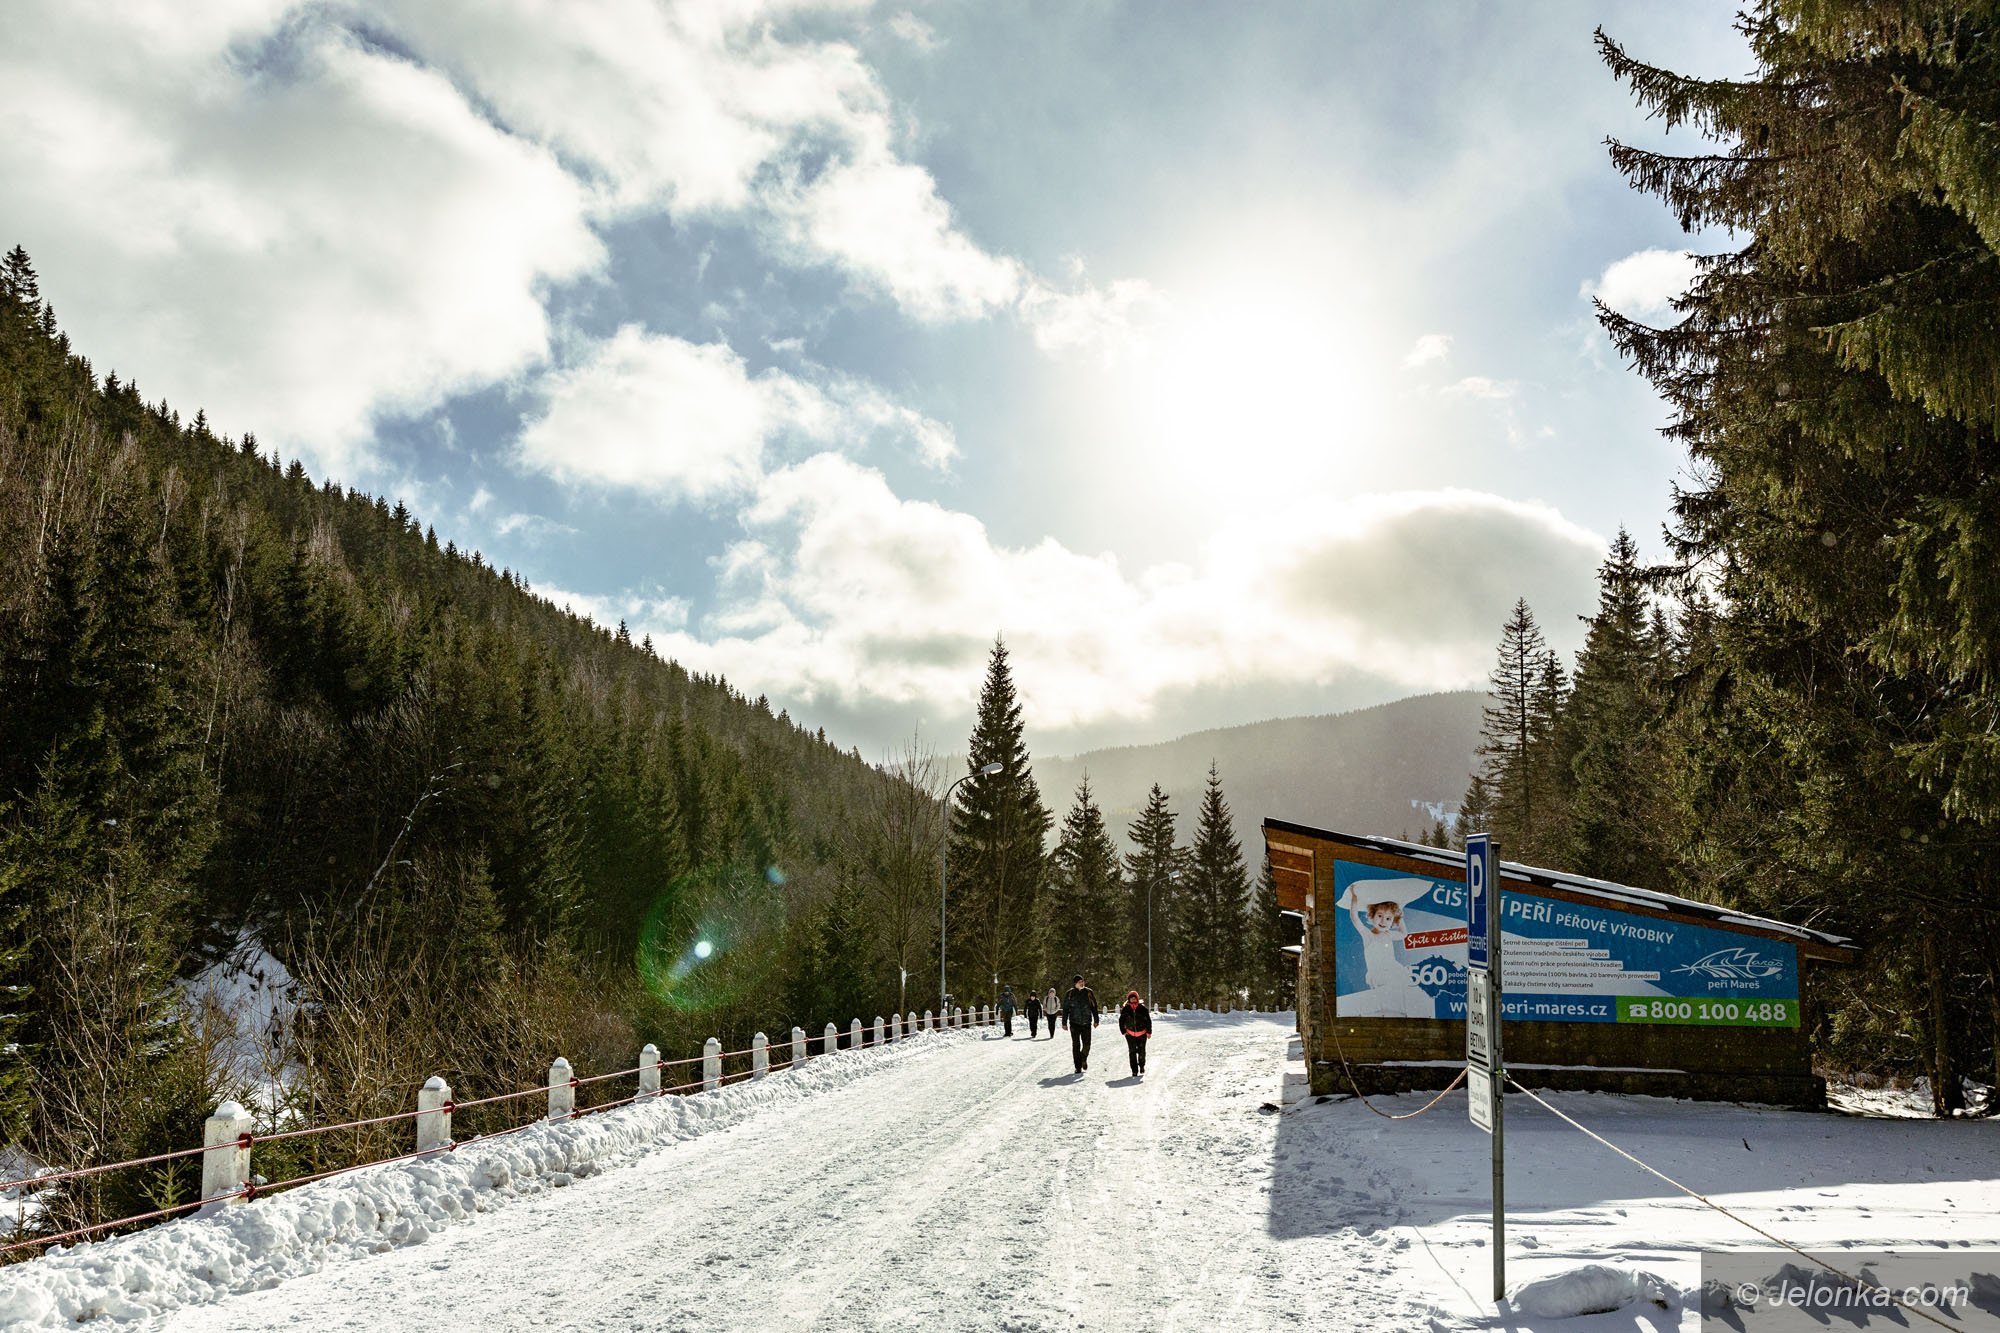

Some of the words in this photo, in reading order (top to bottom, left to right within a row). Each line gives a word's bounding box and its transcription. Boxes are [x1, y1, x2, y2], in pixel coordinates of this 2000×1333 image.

[1471, 854, 1483, 924] P
[1509, 900, 1554, 923] PEŘÍ
[1556, 911, 1608, 933] PÉŘOVÉ
[1610, 922, 1675, 945] VÝROBKY
[1409, 964, 1447, 986] 560
[1708, 980, 1728, 991] peří
[1730, 980, 1760, 989] Mareš
[1651, 1002, 1692, 1020] 800
[1699, 1003, 1739, 1020] 100
[1745, 1003, 1787, 1022] 488
